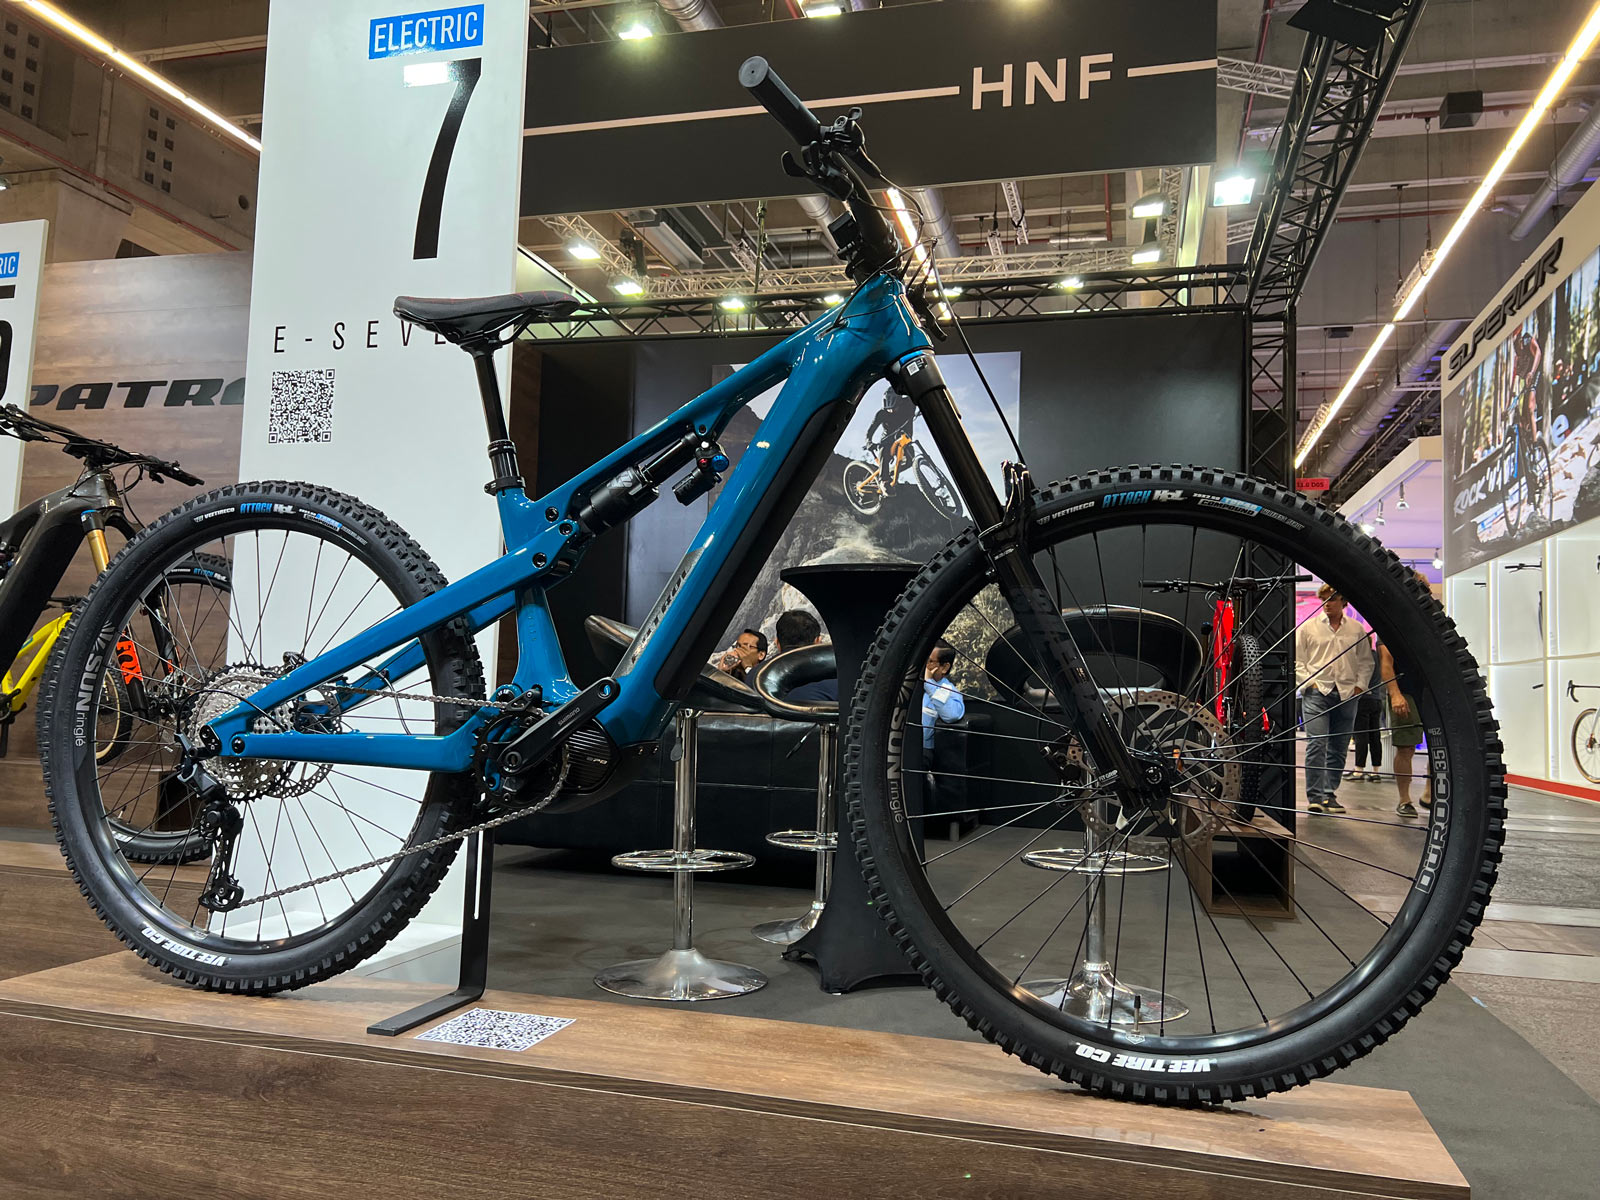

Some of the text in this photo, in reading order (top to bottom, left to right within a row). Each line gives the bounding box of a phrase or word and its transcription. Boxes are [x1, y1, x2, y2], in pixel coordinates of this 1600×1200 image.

[374, 16, 478, 53] ELECTRIC
[972, 53, 1113, 110] HNF
[403, 57, 482, 260] 7
[1448, 237, 1564, 380] SUPERIOR
[240, 502, 272, 514] ATTACK
[1101, 489, 1152, 509] ATTACK
[1201, 500, 1256, 516] COMPOUND
[73, 652, 103, 747] SUN ringlé
[887, 706, 907, 824] SUN ringlé
[1434, 749, 1447, 771] 35
